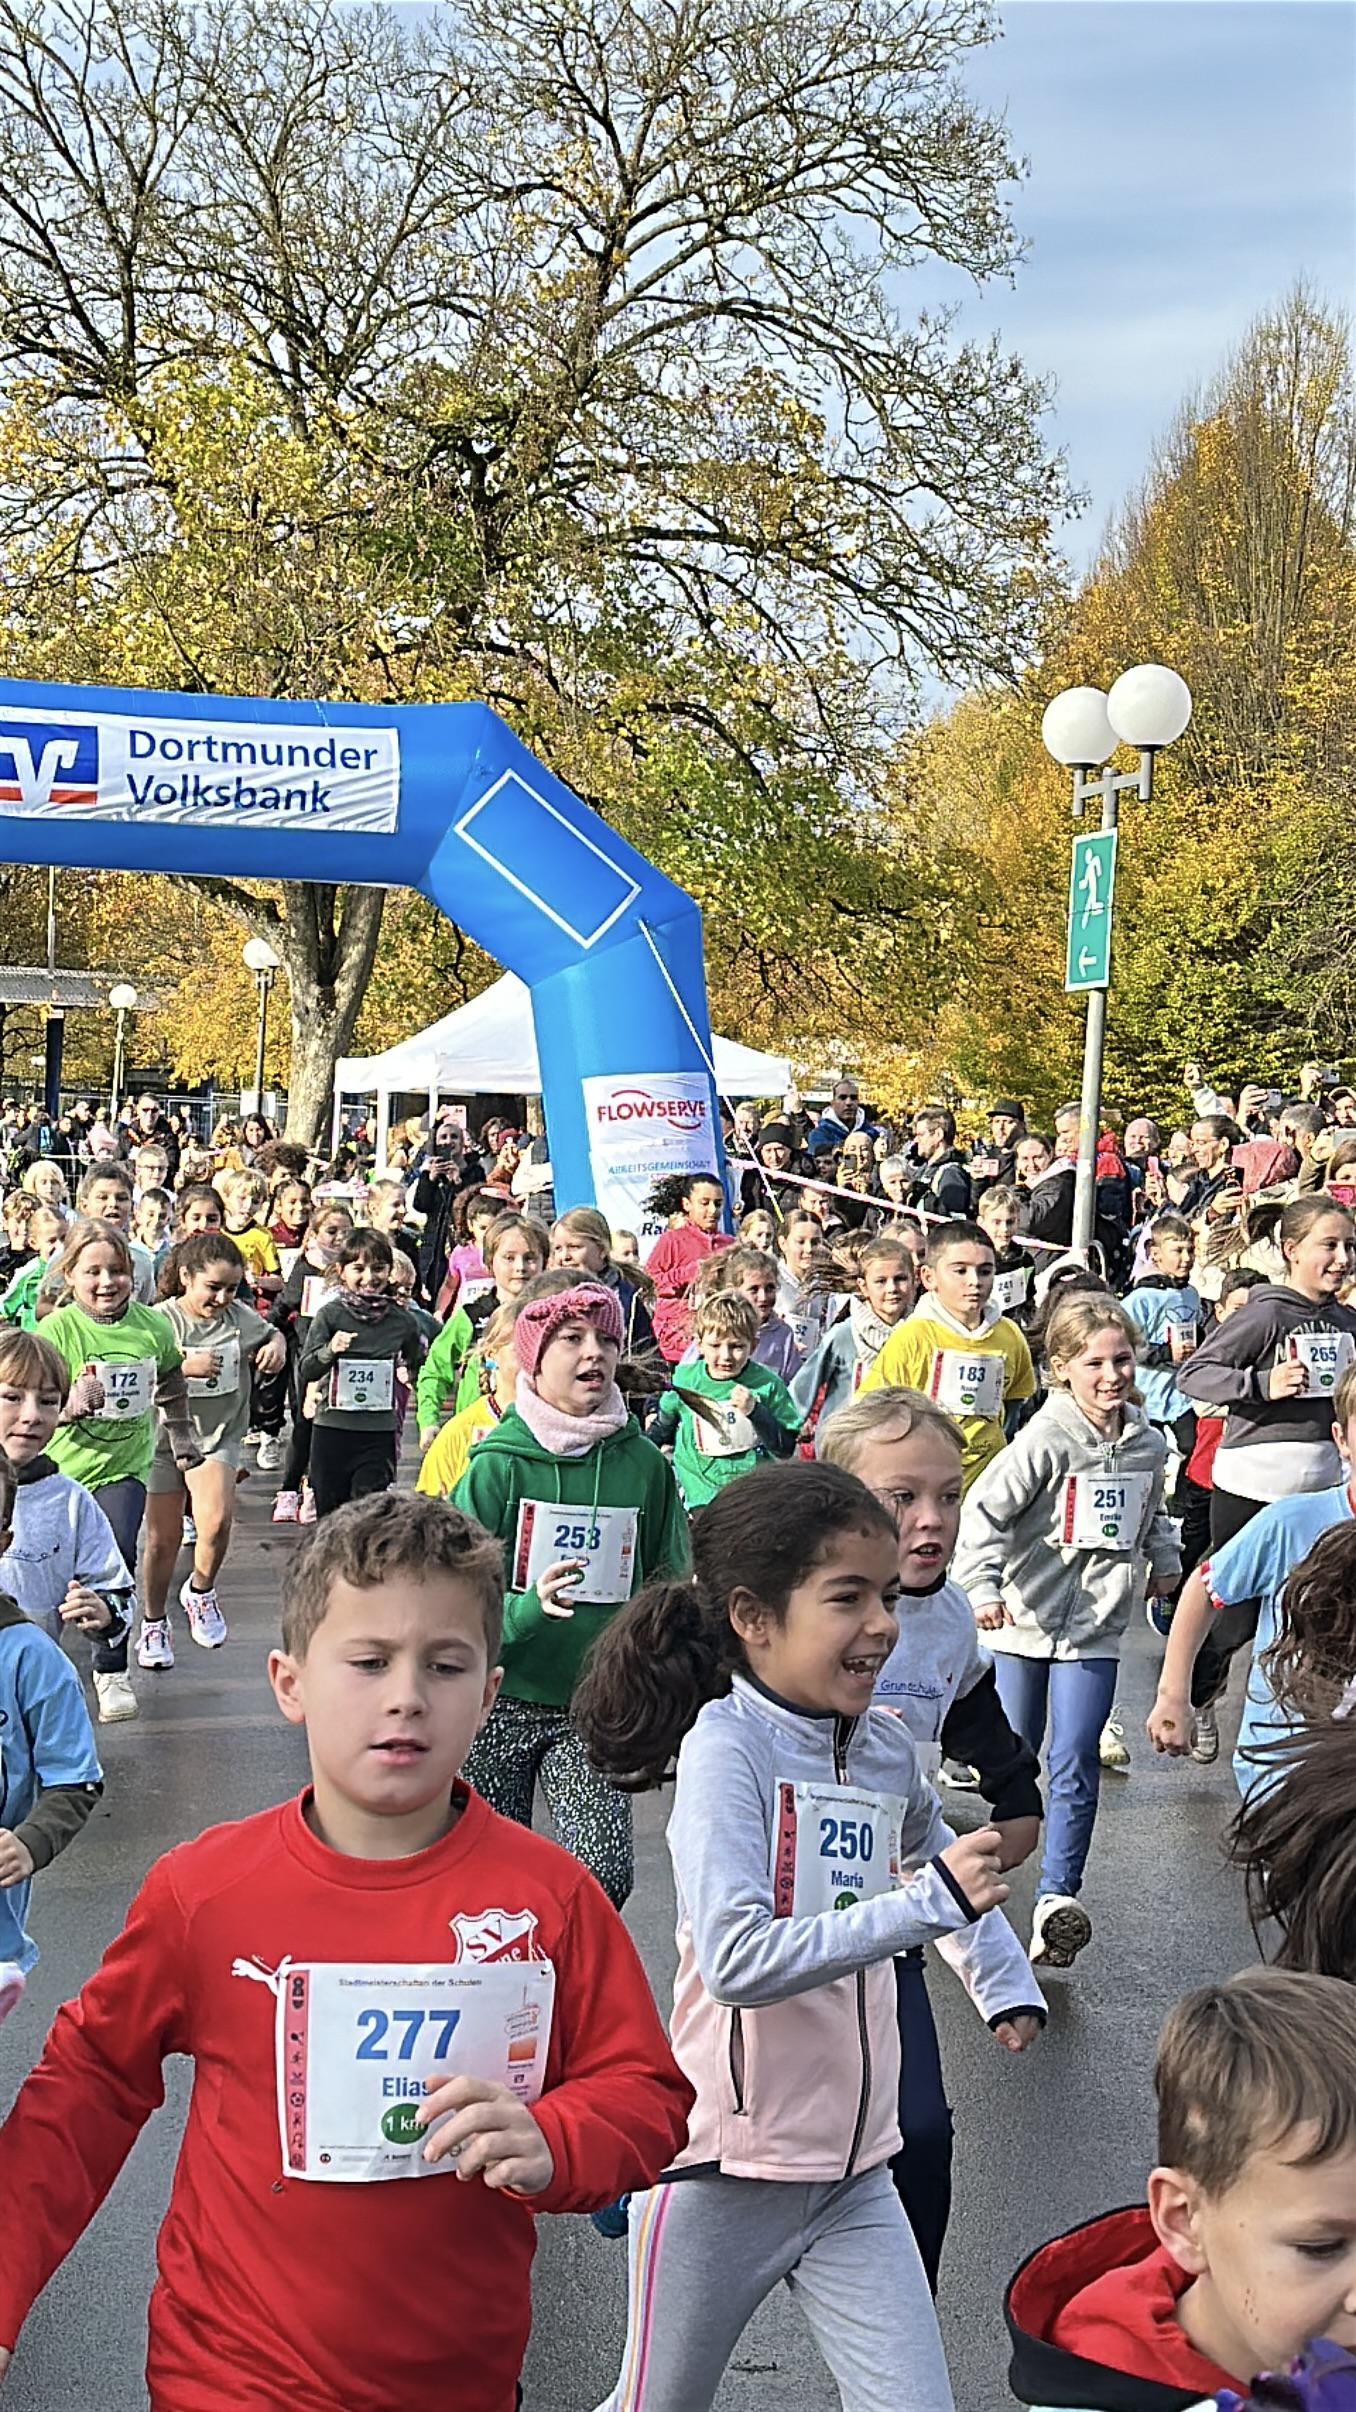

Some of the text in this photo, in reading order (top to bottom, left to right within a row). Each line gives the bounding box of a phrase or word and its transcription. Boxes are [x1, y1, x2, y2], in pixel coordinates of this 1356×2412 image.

[129, 729, 379, 770] Dortmunder
[127, 773, 331, 813] Volksbank
[597, 1100, 706, 1122] FLOWSERVE
[1310, 1346, 1337, 1362] 265
[110, 1372, 138, 1388] 172
[348, 1370, 374, 1384] 234
[958, 1366, 987, 1382] 183
[1093, 1489, 1126, 1508] 251
[819, 1818, 874, 1862] 250
[466, 1919, 503, 1959] SV
[355, 2009, 462, 2060] 277
[386, 2115, 395, 2131] 1
